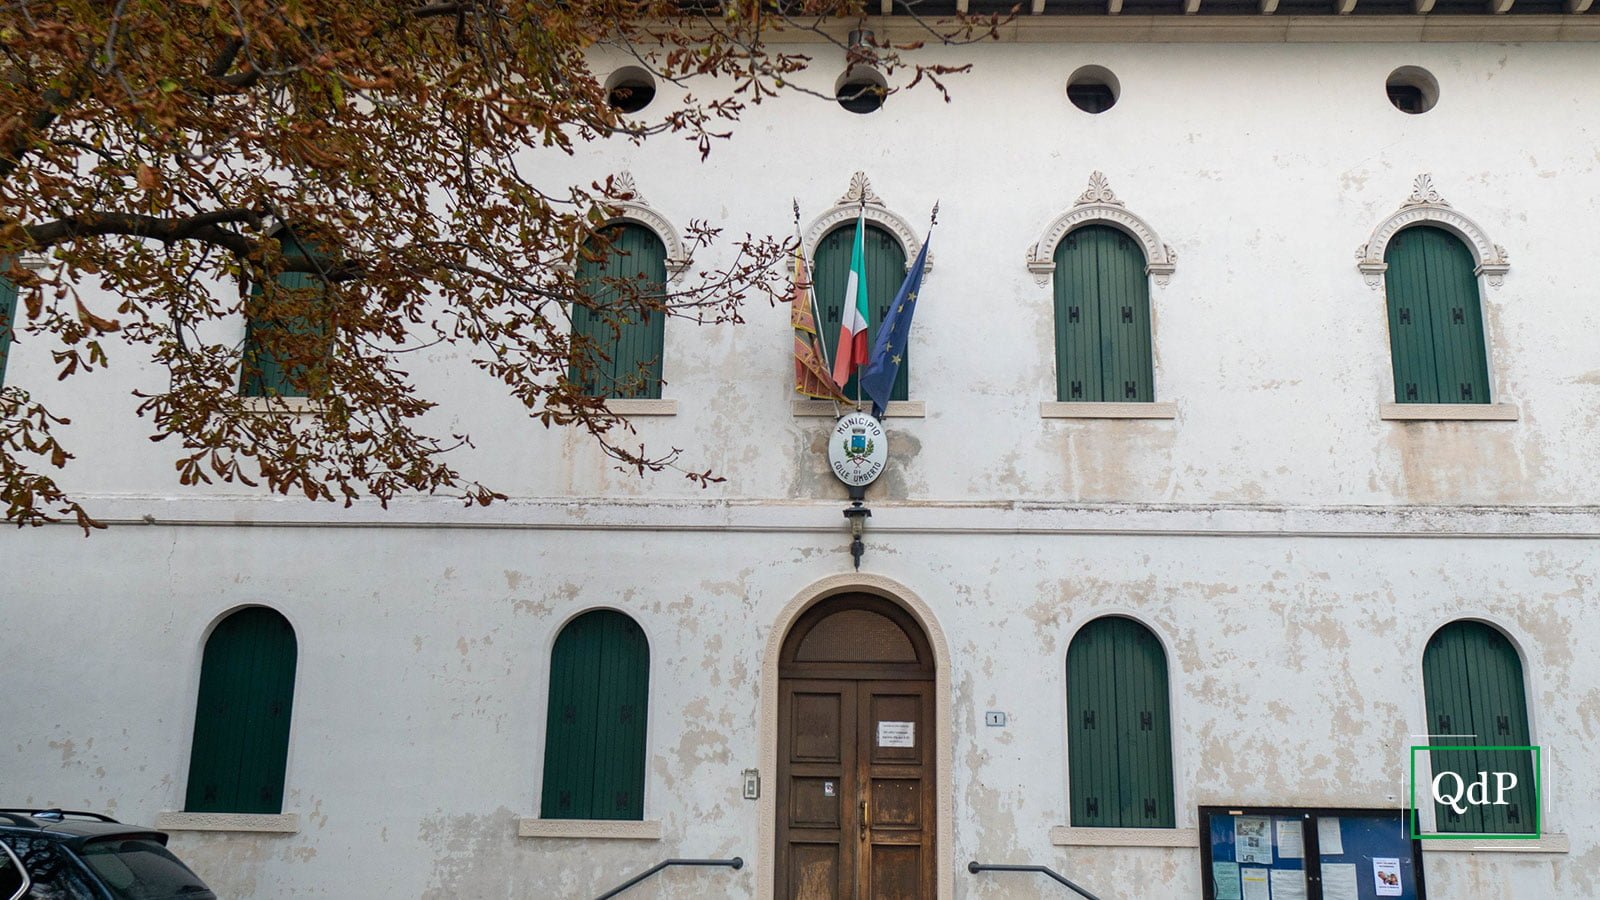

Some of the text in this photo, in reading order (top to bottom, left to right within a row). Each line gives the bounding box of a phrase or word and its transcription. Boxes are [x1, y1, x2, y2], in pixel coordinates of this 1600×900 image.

[837, 418, 881, 436] MUNICIPIO
[834, 460, 881, 482] COLLE UMBERTO
[993, 715, 998, 724] 1
